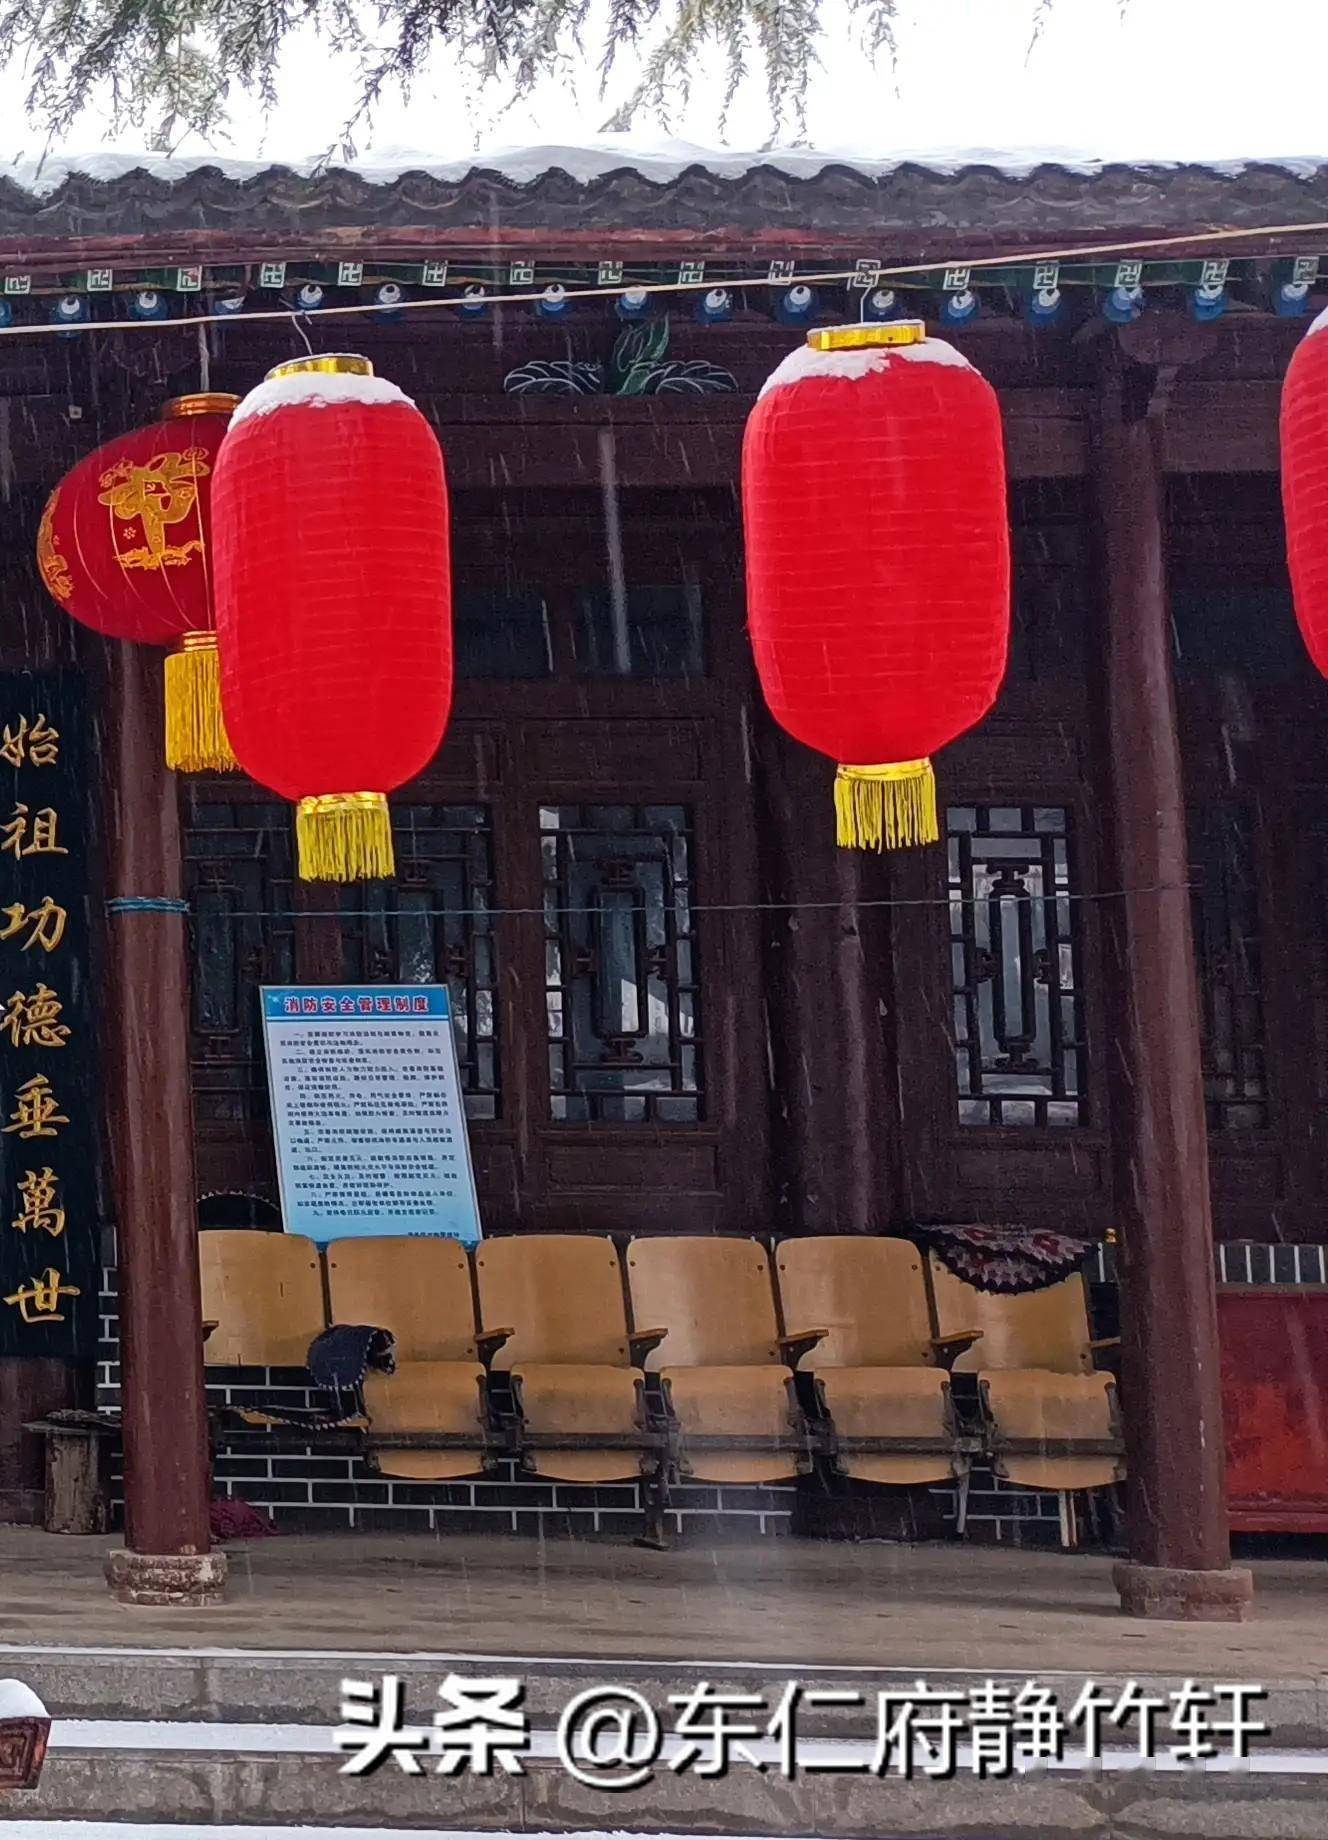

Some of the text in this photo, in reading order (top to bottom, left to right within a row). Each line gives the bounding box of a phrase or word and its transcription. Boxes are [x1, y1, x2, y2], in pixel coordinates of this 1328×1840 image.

[285, 995, 429, 1013] 消防安全管理制度
